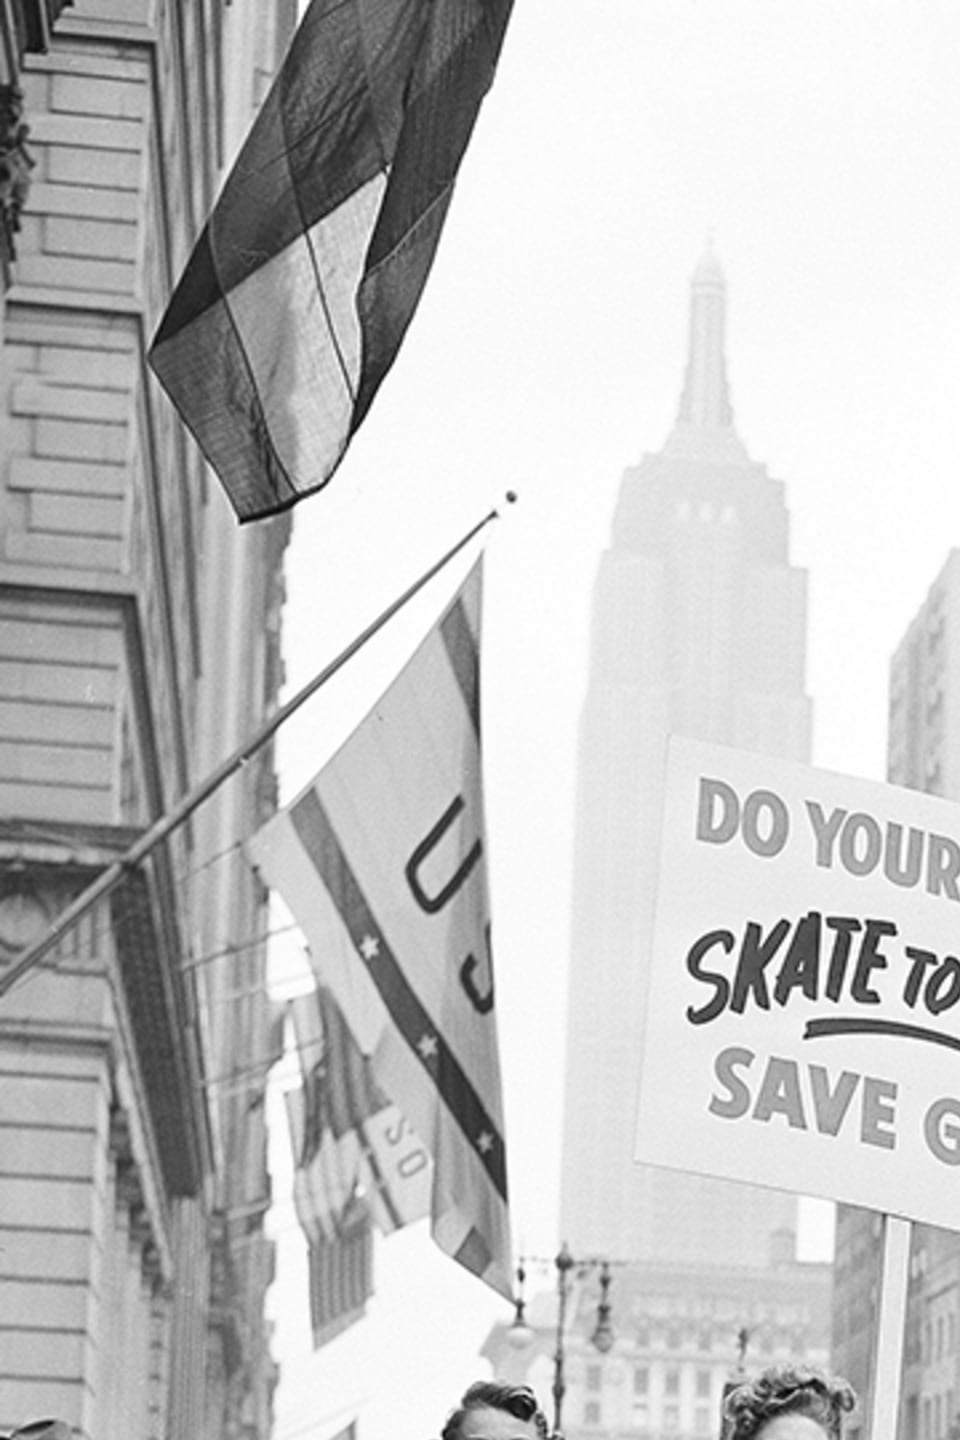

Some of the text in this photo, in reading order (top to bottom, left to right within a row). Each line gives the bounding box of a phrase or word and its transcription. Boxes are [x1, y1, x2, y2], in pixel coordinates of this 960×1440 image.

[695, 776, 790, 858] DO
[686, 911, 898, 1025] SKATE
[708, 1046, 898, 1150] SAVE
